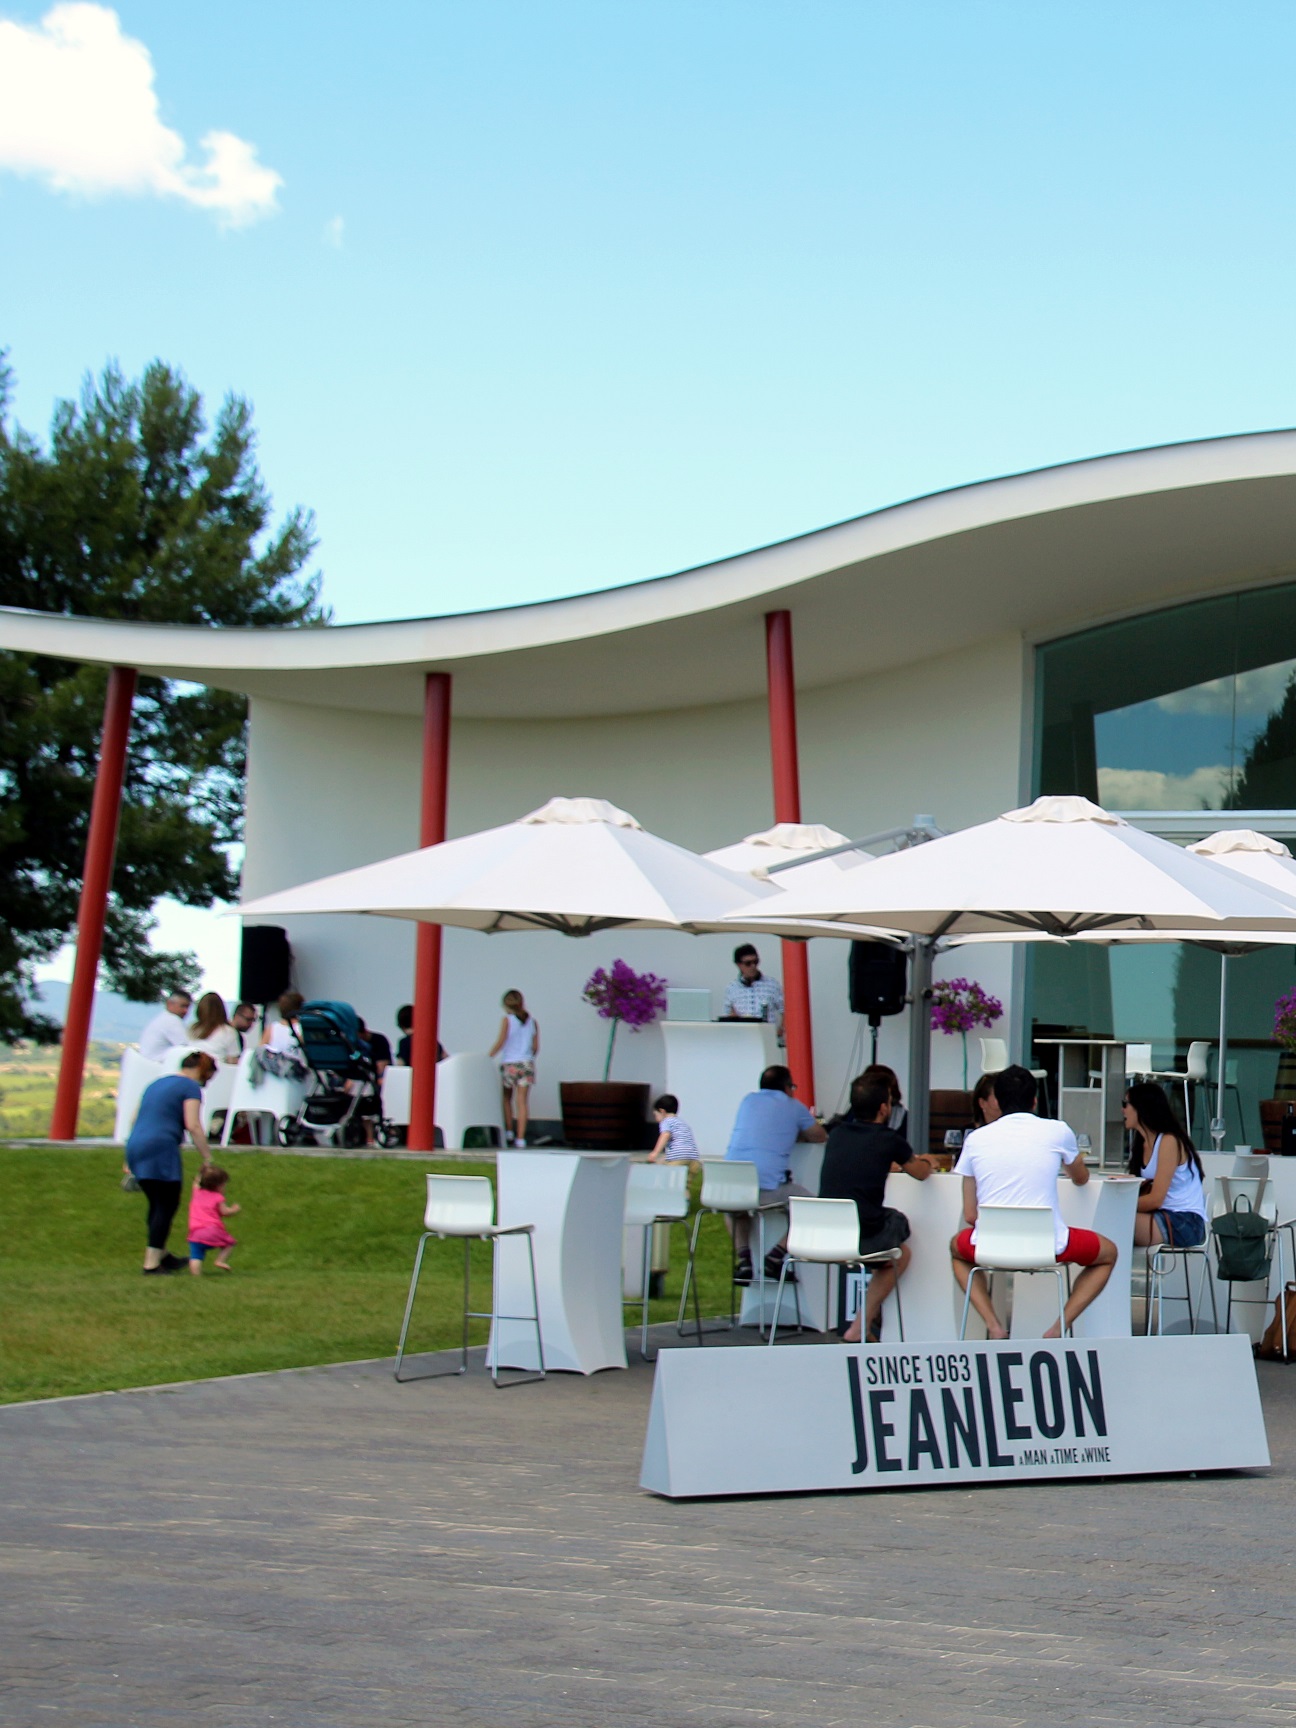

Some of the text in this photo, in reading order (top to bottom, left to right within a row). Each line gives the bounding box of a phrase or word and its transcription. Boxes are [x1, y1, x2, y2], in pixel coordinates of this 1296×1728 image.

[866, 1354, 971, 1385] SINCE 1963
[847, 1350, 1108, 1474] JEAN LEON
